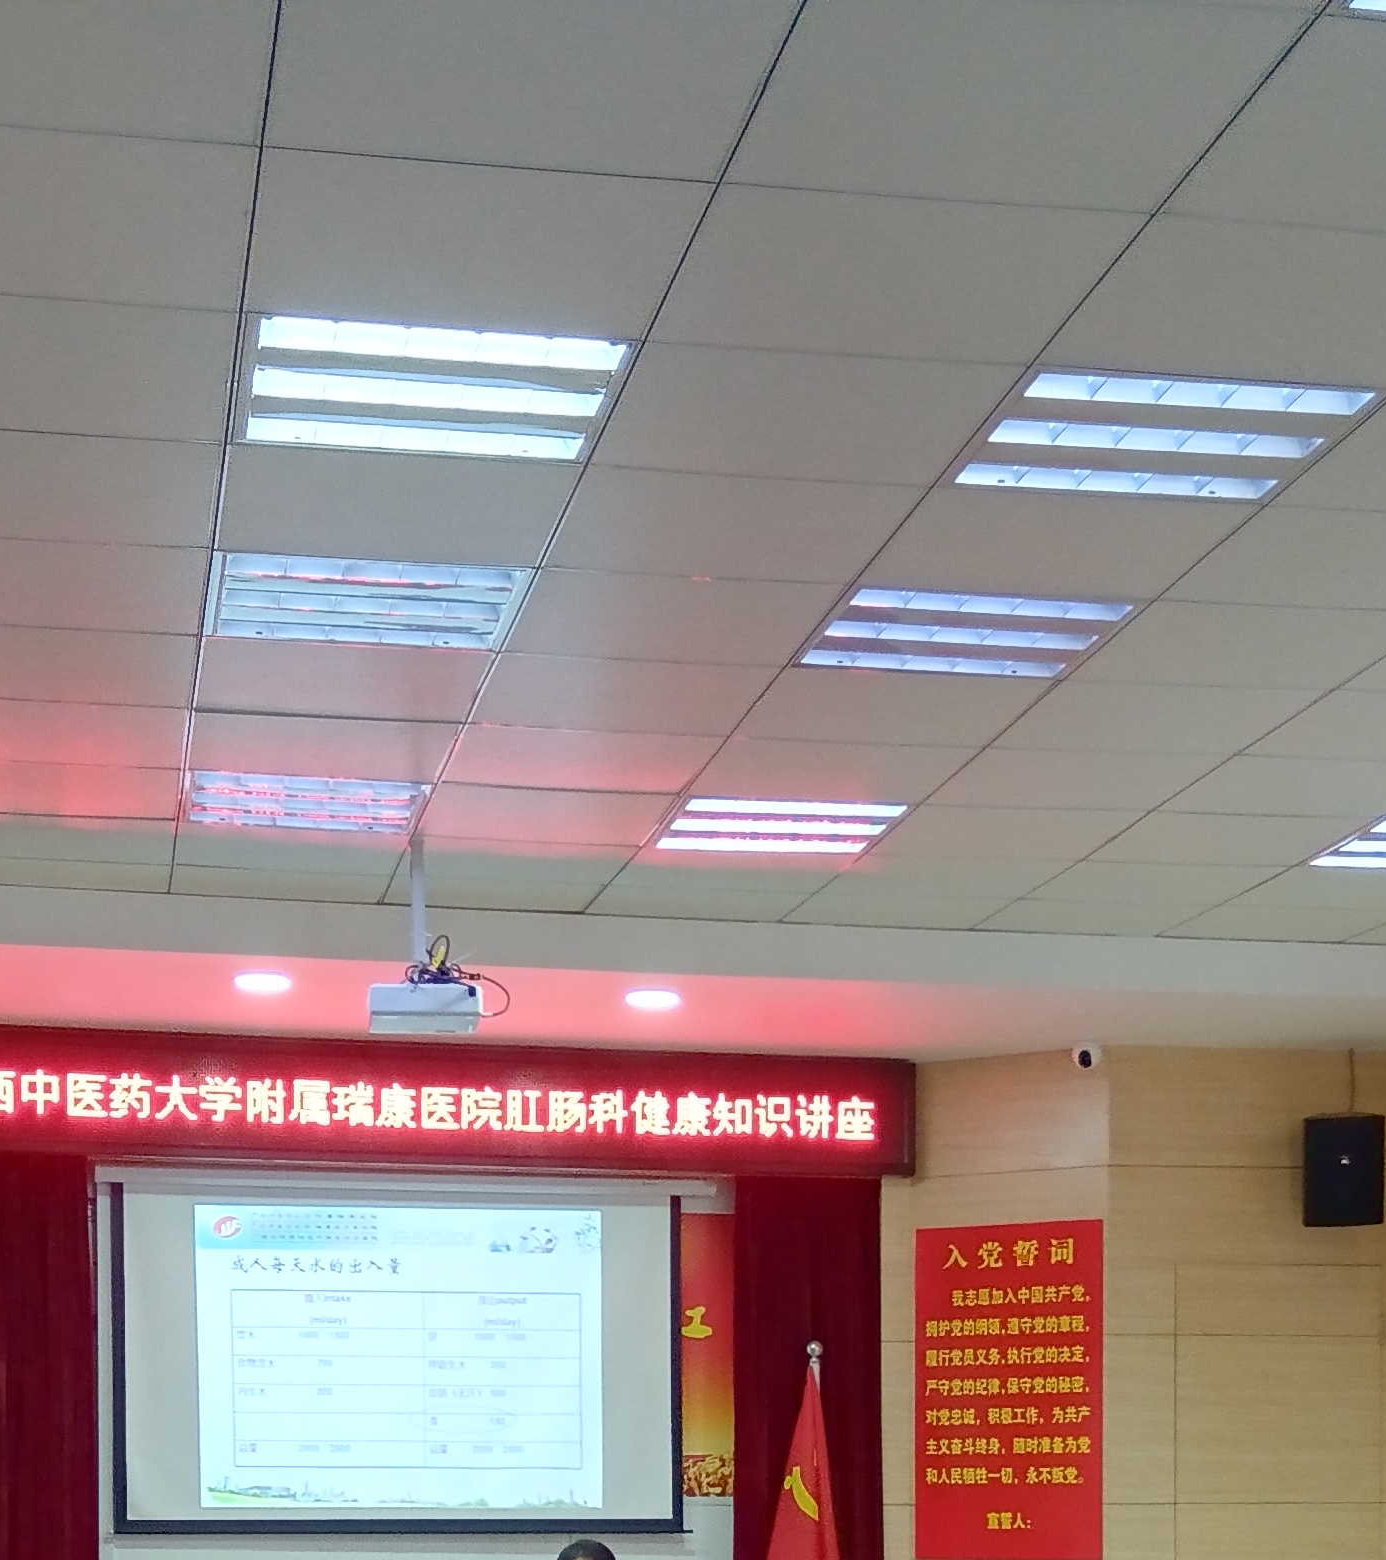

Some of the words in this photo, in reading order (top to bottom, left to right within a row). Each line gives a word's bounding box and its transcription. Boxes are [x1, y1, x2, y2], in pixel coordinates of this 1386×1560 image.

[231, 1255, 401, 1276] 成人每天水的出入量
[942, 1238, 1075, 1270] 入党誓词
